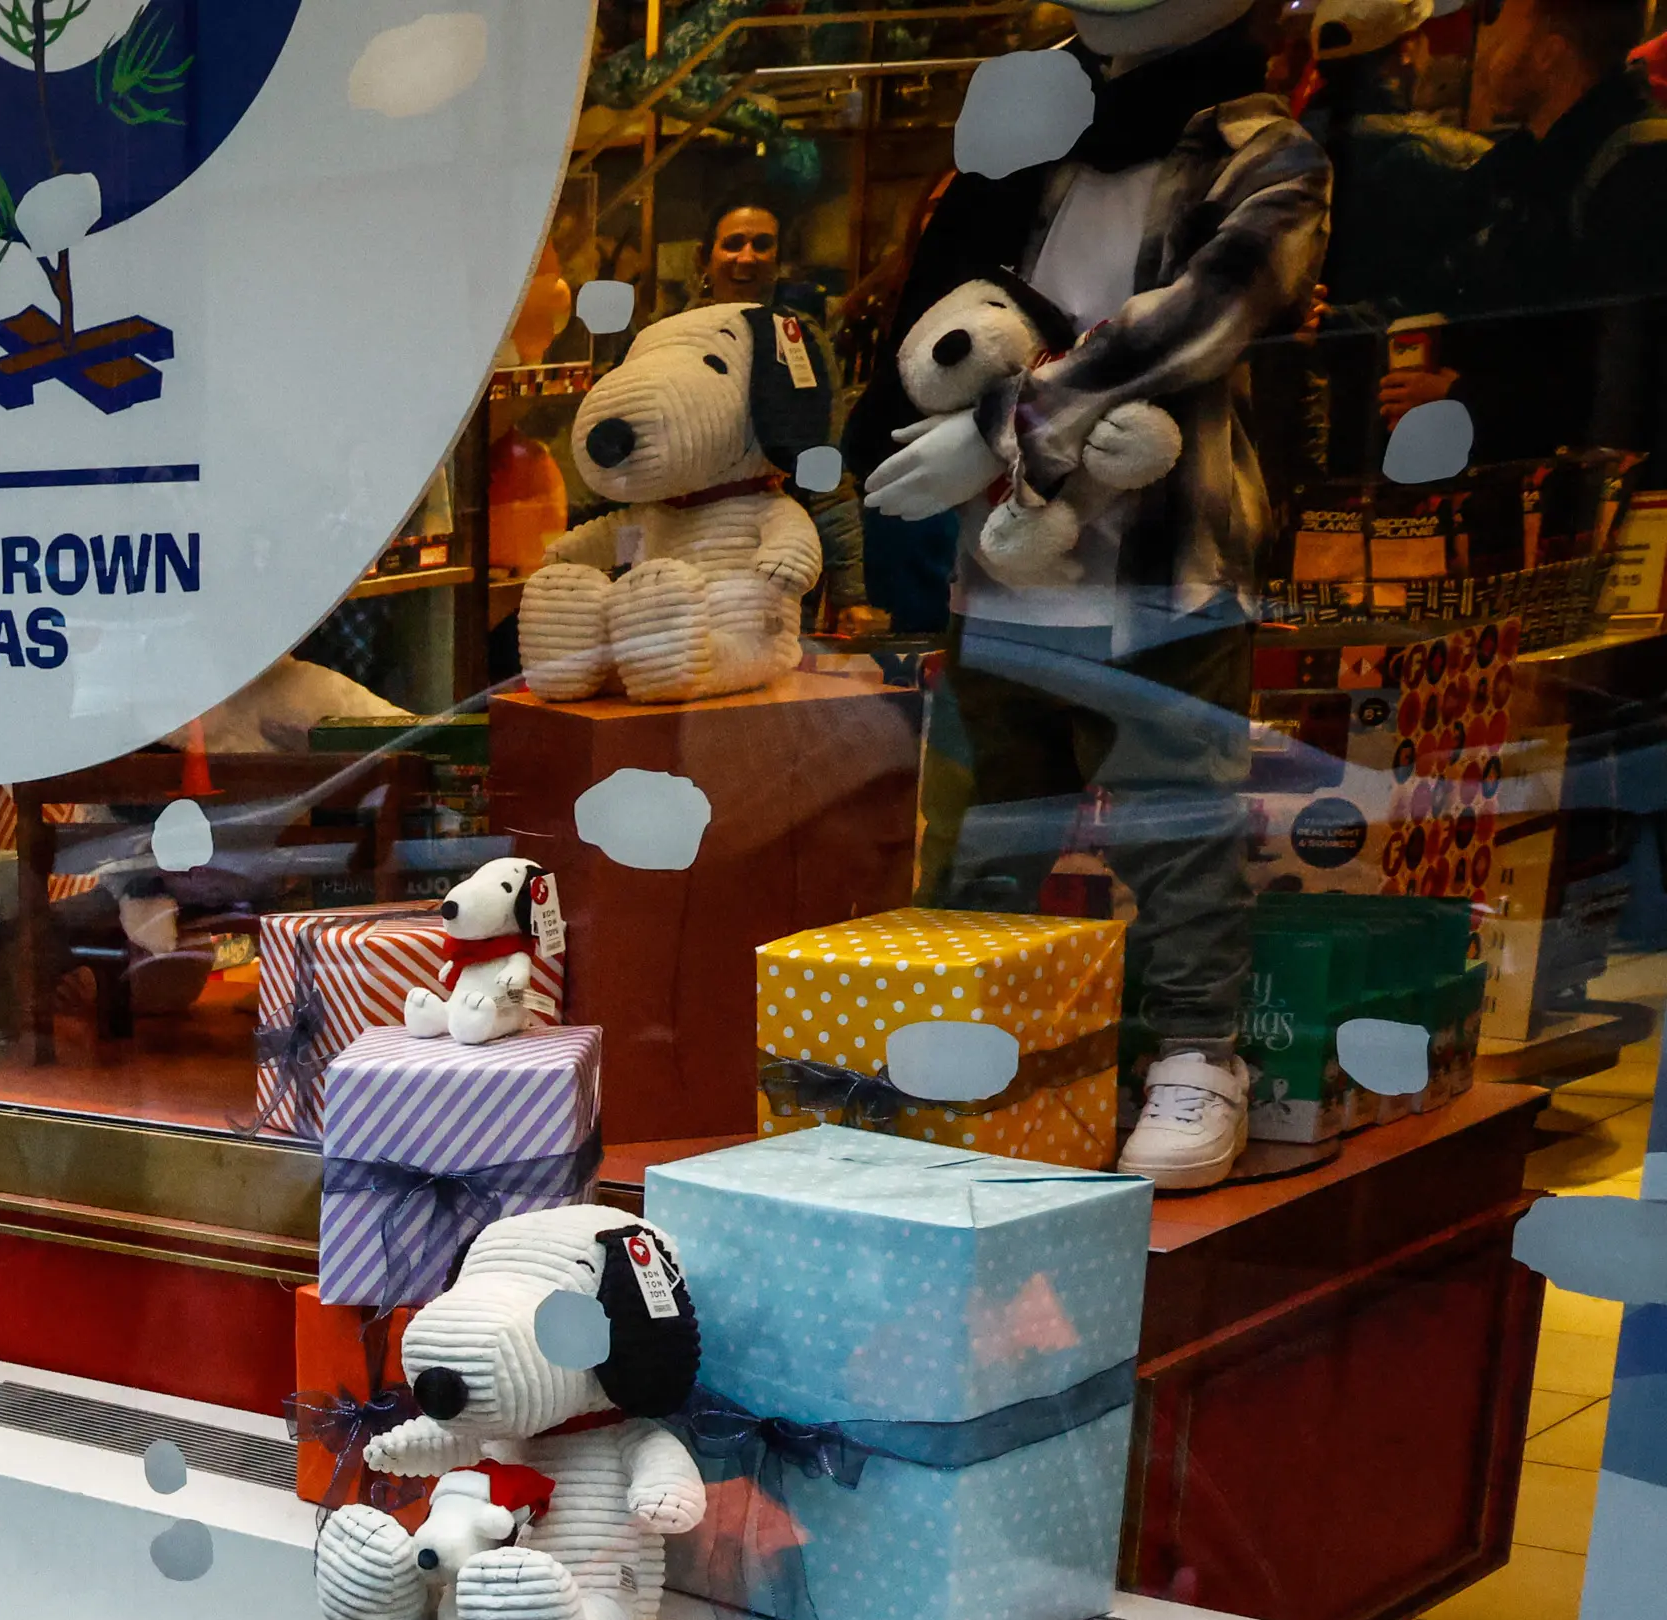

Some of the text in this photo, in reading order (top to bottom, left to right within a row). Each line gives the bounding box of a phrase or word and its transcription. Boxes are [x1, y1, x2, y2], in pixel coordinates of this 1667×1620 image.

[642, 1270, 660, 1279] BON
[645, 1280, 663, 1288] TON
[649, 1289, 667, 1299] TOYS
